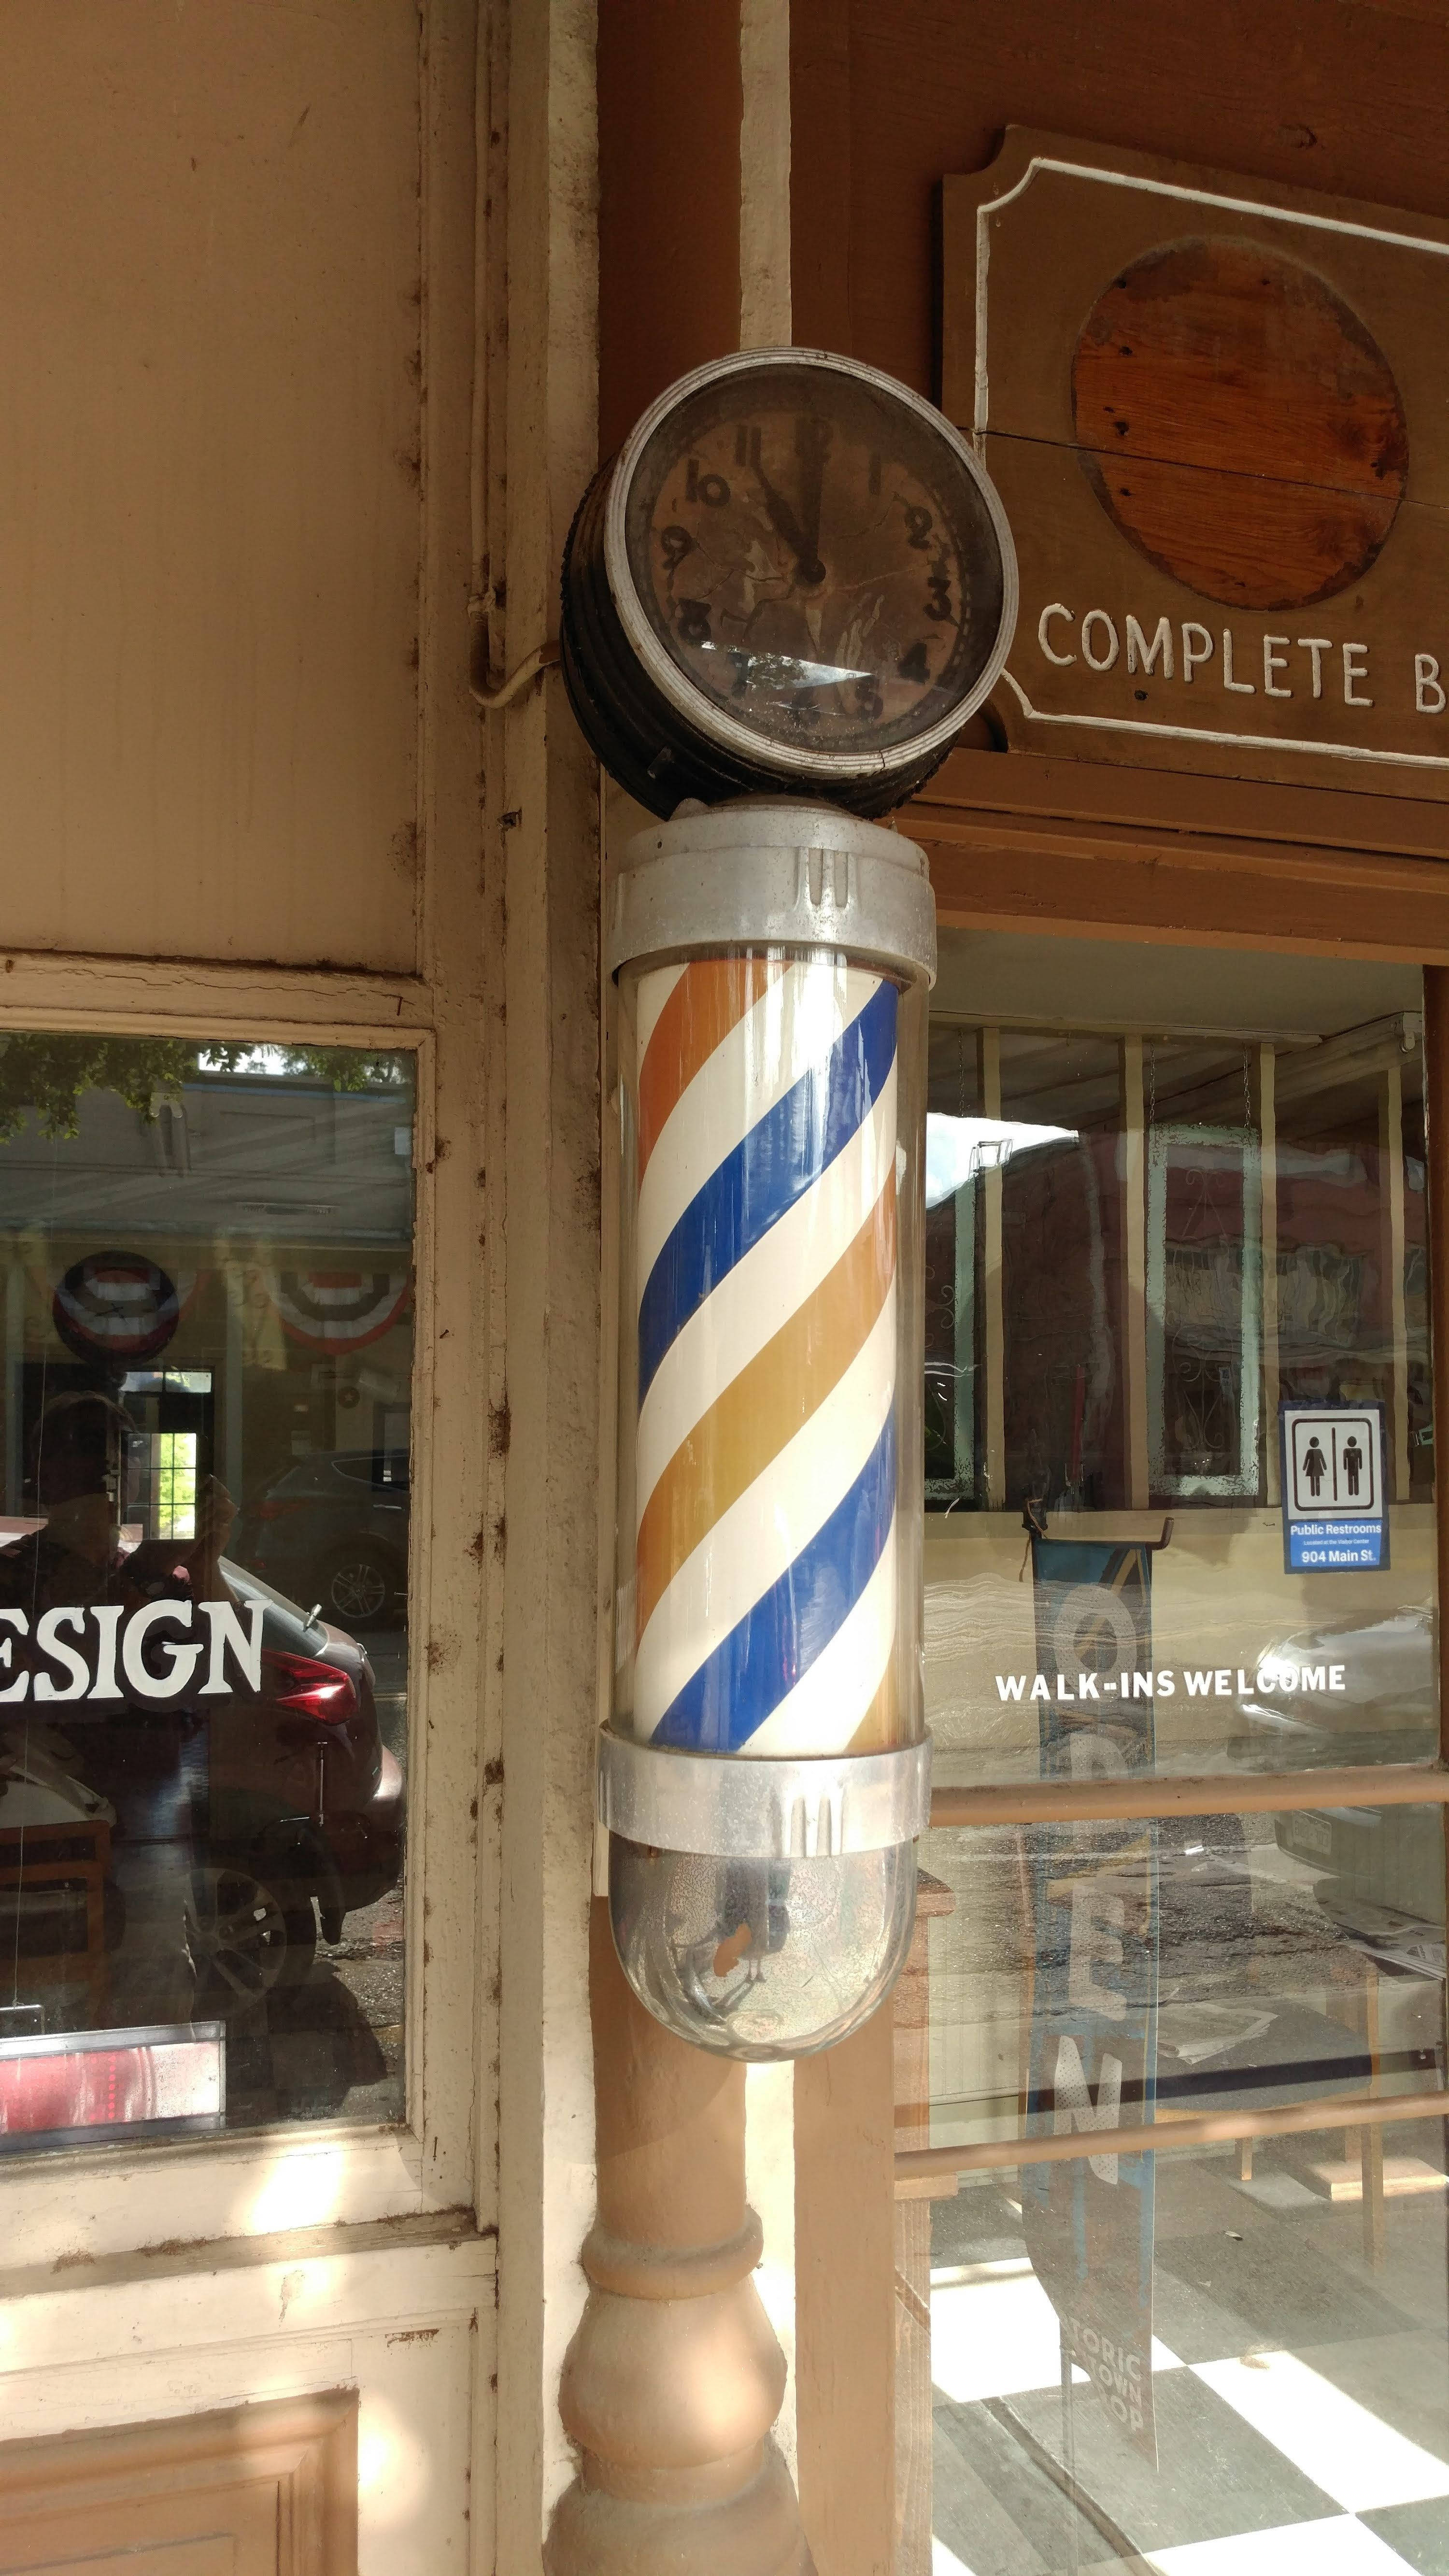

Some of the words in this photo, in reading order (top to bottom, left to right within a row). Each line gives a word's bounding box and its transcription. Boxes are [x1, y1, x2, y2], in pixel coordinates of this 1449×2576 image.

[685, 459, 730, 507] 10
[661, 526, 692, 570] 9
[904, 506, 932, 550] 2
[923, 577, 952, 621] 3
[1038, 603, 1374, 707] COMPLETE
[1415, 654, 1446, 713] B
[1291, 1524, 1324, 1536] Public
[1326, 1524, 1382, 1535] Restrooms
[1302, 1551, 1326, 1563] 904
[1329, 1550, 1359, 1562] Main
[1360, 1549, 1376, 1561] St.
[995, 1670, 1176, 1701] WALK-INS
[1184, 1665, 1346, 1696] WELCOME
